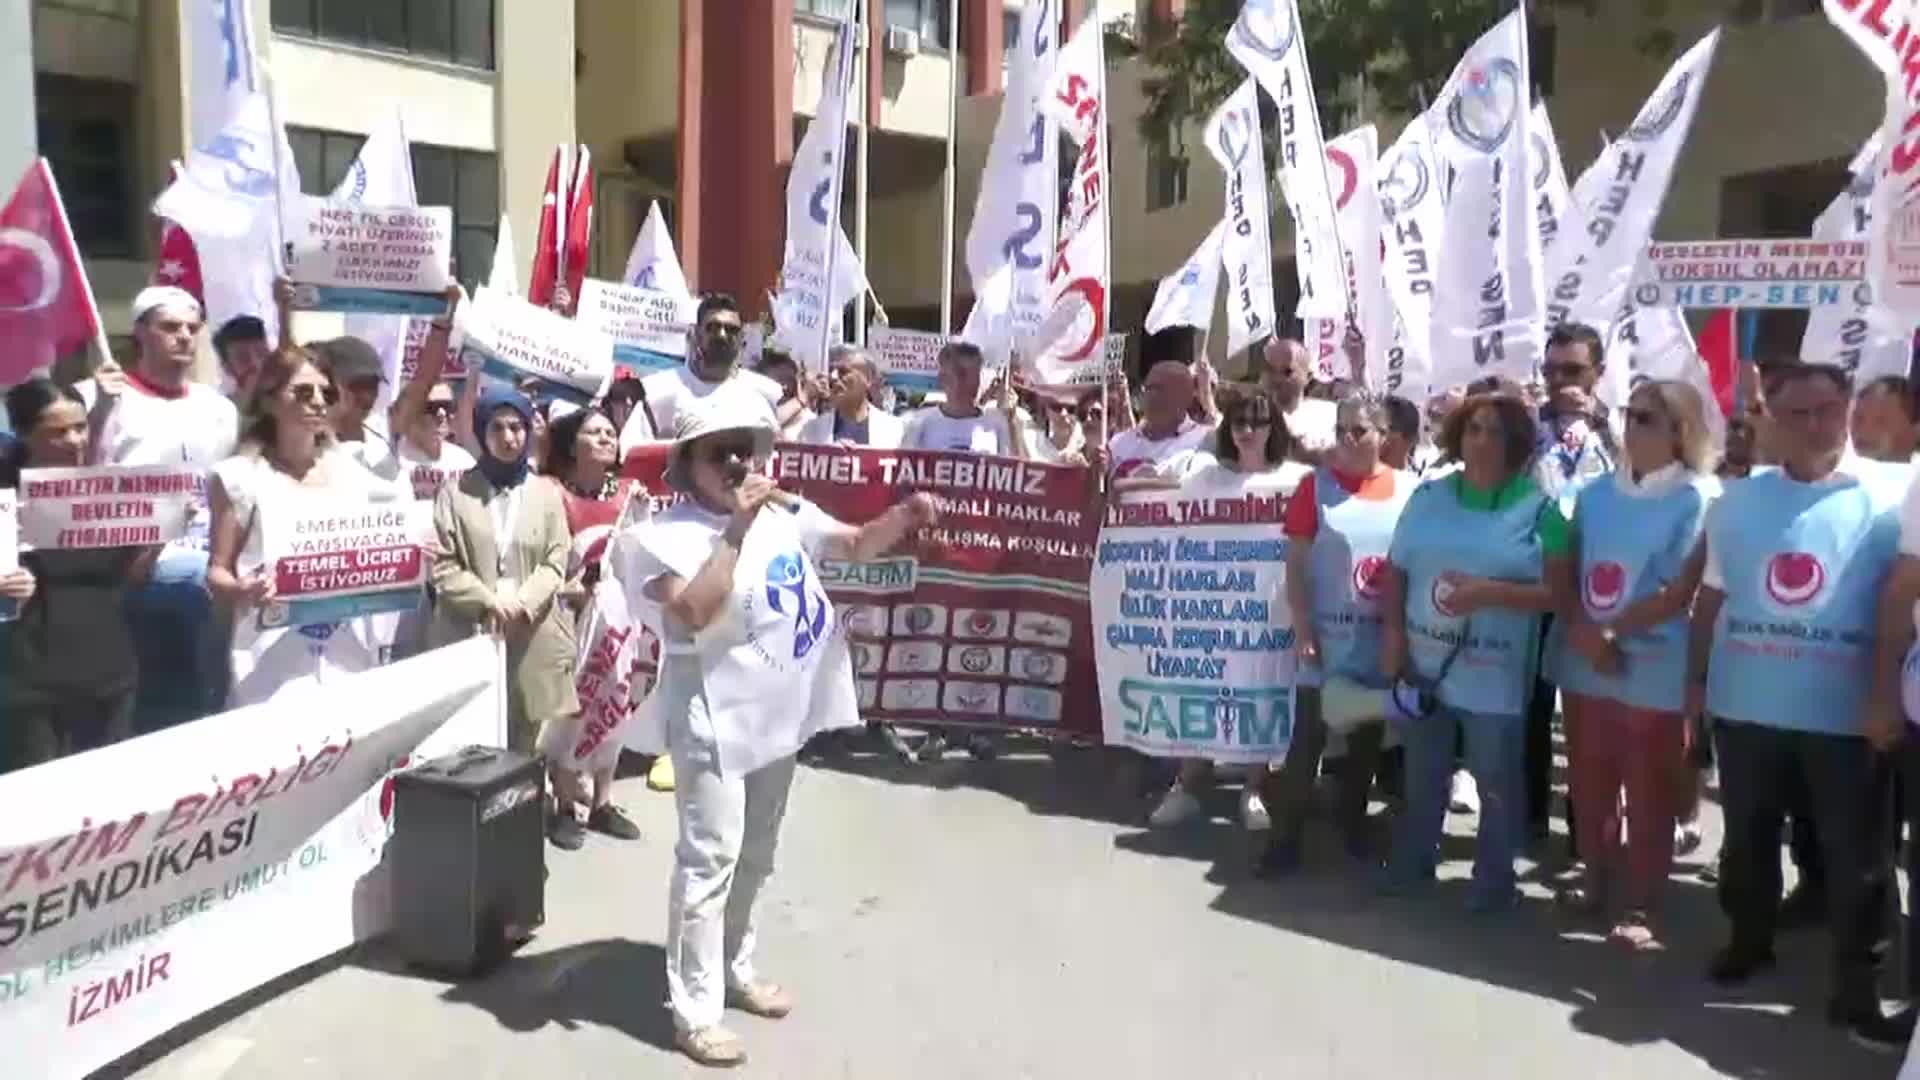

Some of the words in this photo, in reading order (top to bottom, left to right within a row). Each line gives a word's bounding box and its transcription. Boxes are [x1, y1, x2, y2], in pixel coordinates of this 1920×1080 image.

[1658, 262, 1746, 281] YOKSUL
[766, 451, 868, 485] TEMEL
[879, 456, 1048, 496] TALEBİMİZ
[997, 501, 1081, 527] HAKLAR
[1007, 533, 1096, 559] KOŞULLA
[284, 555, 350, 575] TEMEL
[356, 546, 413, 567] ÜCRET
[0, 812, 147, 893] KİM
[298, 842, 328, 868] OL
[68, 951, 171, 1027] İZMİR
